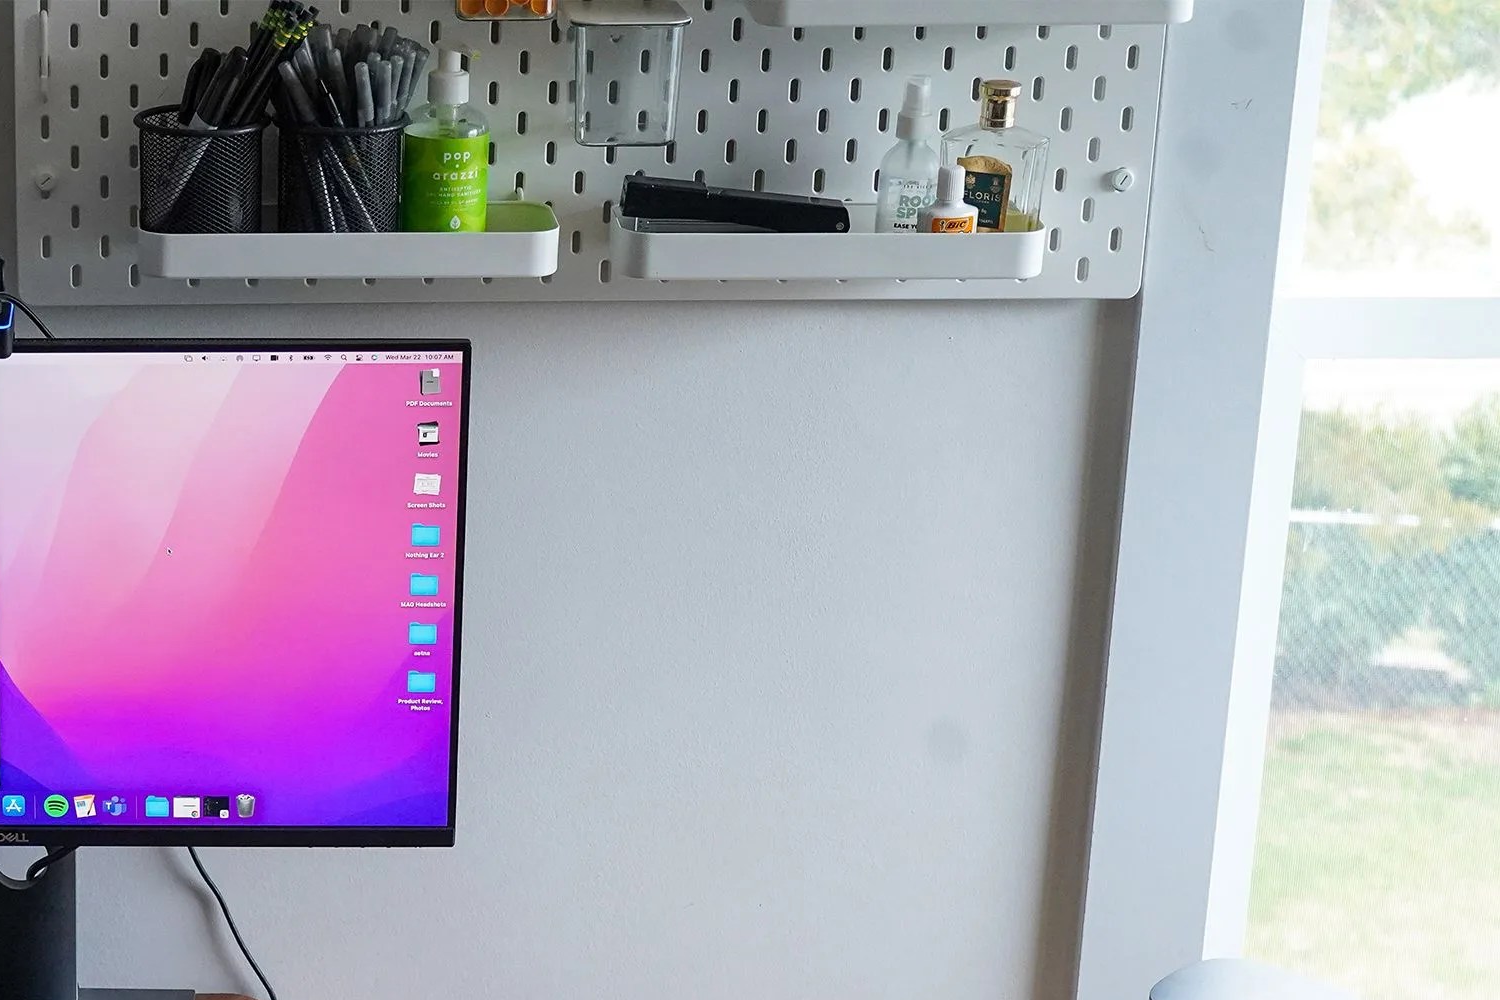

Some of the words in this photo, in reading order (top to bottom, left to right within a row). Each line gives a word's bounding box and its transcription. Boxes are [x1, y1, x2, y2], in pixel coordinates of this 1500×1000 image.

[443, 151, 471, 164] pop
[432, 166, 478, 180] arazzi
[964, 191, 1000, 202] FLORIS
[946, 220, 967, 230] BIC
